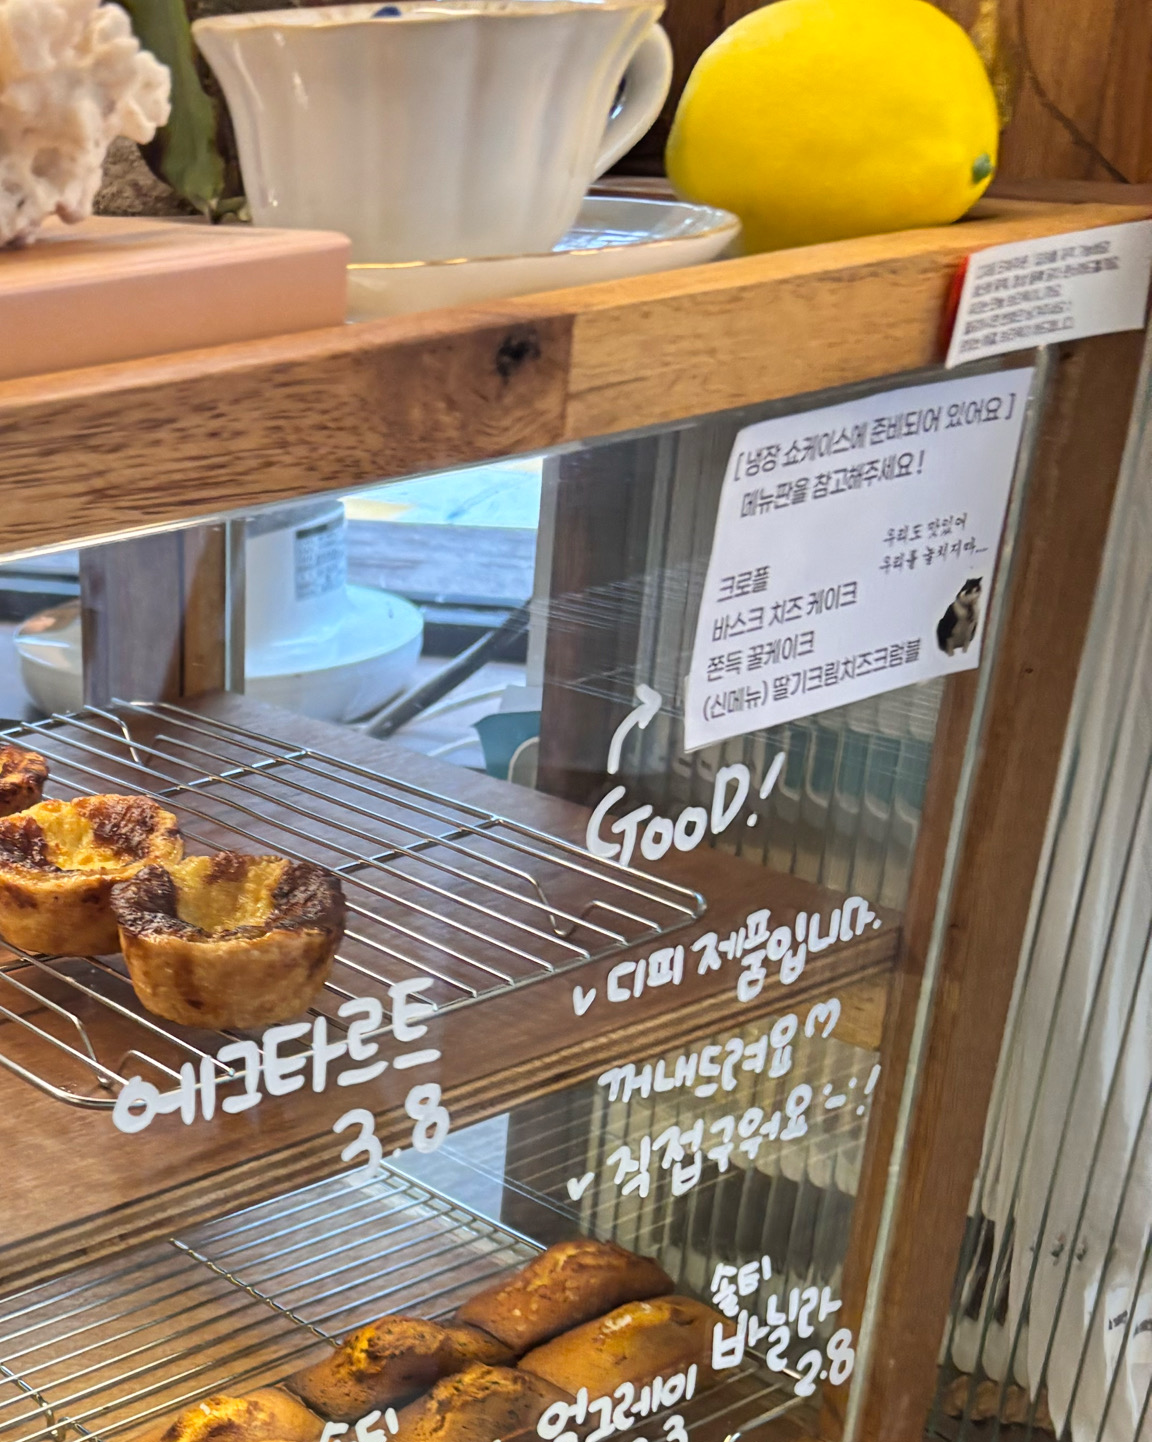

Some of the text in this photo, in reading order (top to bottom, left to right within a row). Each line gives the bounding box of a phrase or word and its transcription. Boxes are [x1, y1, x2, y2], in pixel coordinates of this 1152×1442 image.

[782, 421, 866, 467] 쇼케이스에
[870, 406, 941, 446] 준비되어
[740, 477, 810, 518] 메뉴판을
[883, 523, 922, 547] 우리도
[712, 581, 858, 642] 바스크 치즈 케이크
[716, 565, 771, 603] 크로플
[707, 630, 815, 683] 쫀득 꿀케이크
[703, 680, 769, 722] (신메뉴)
[607, 945, 684, 1002] 디피
[112, 977, 441, 1133] 에그타르트
[332, 1083, 450, 1184] 3.8
[710, 1255, 772, 1317] 솔티
[712, 1286, 842, 1372] 바닐라
[794, 1328, 855, 1397] 2.8
